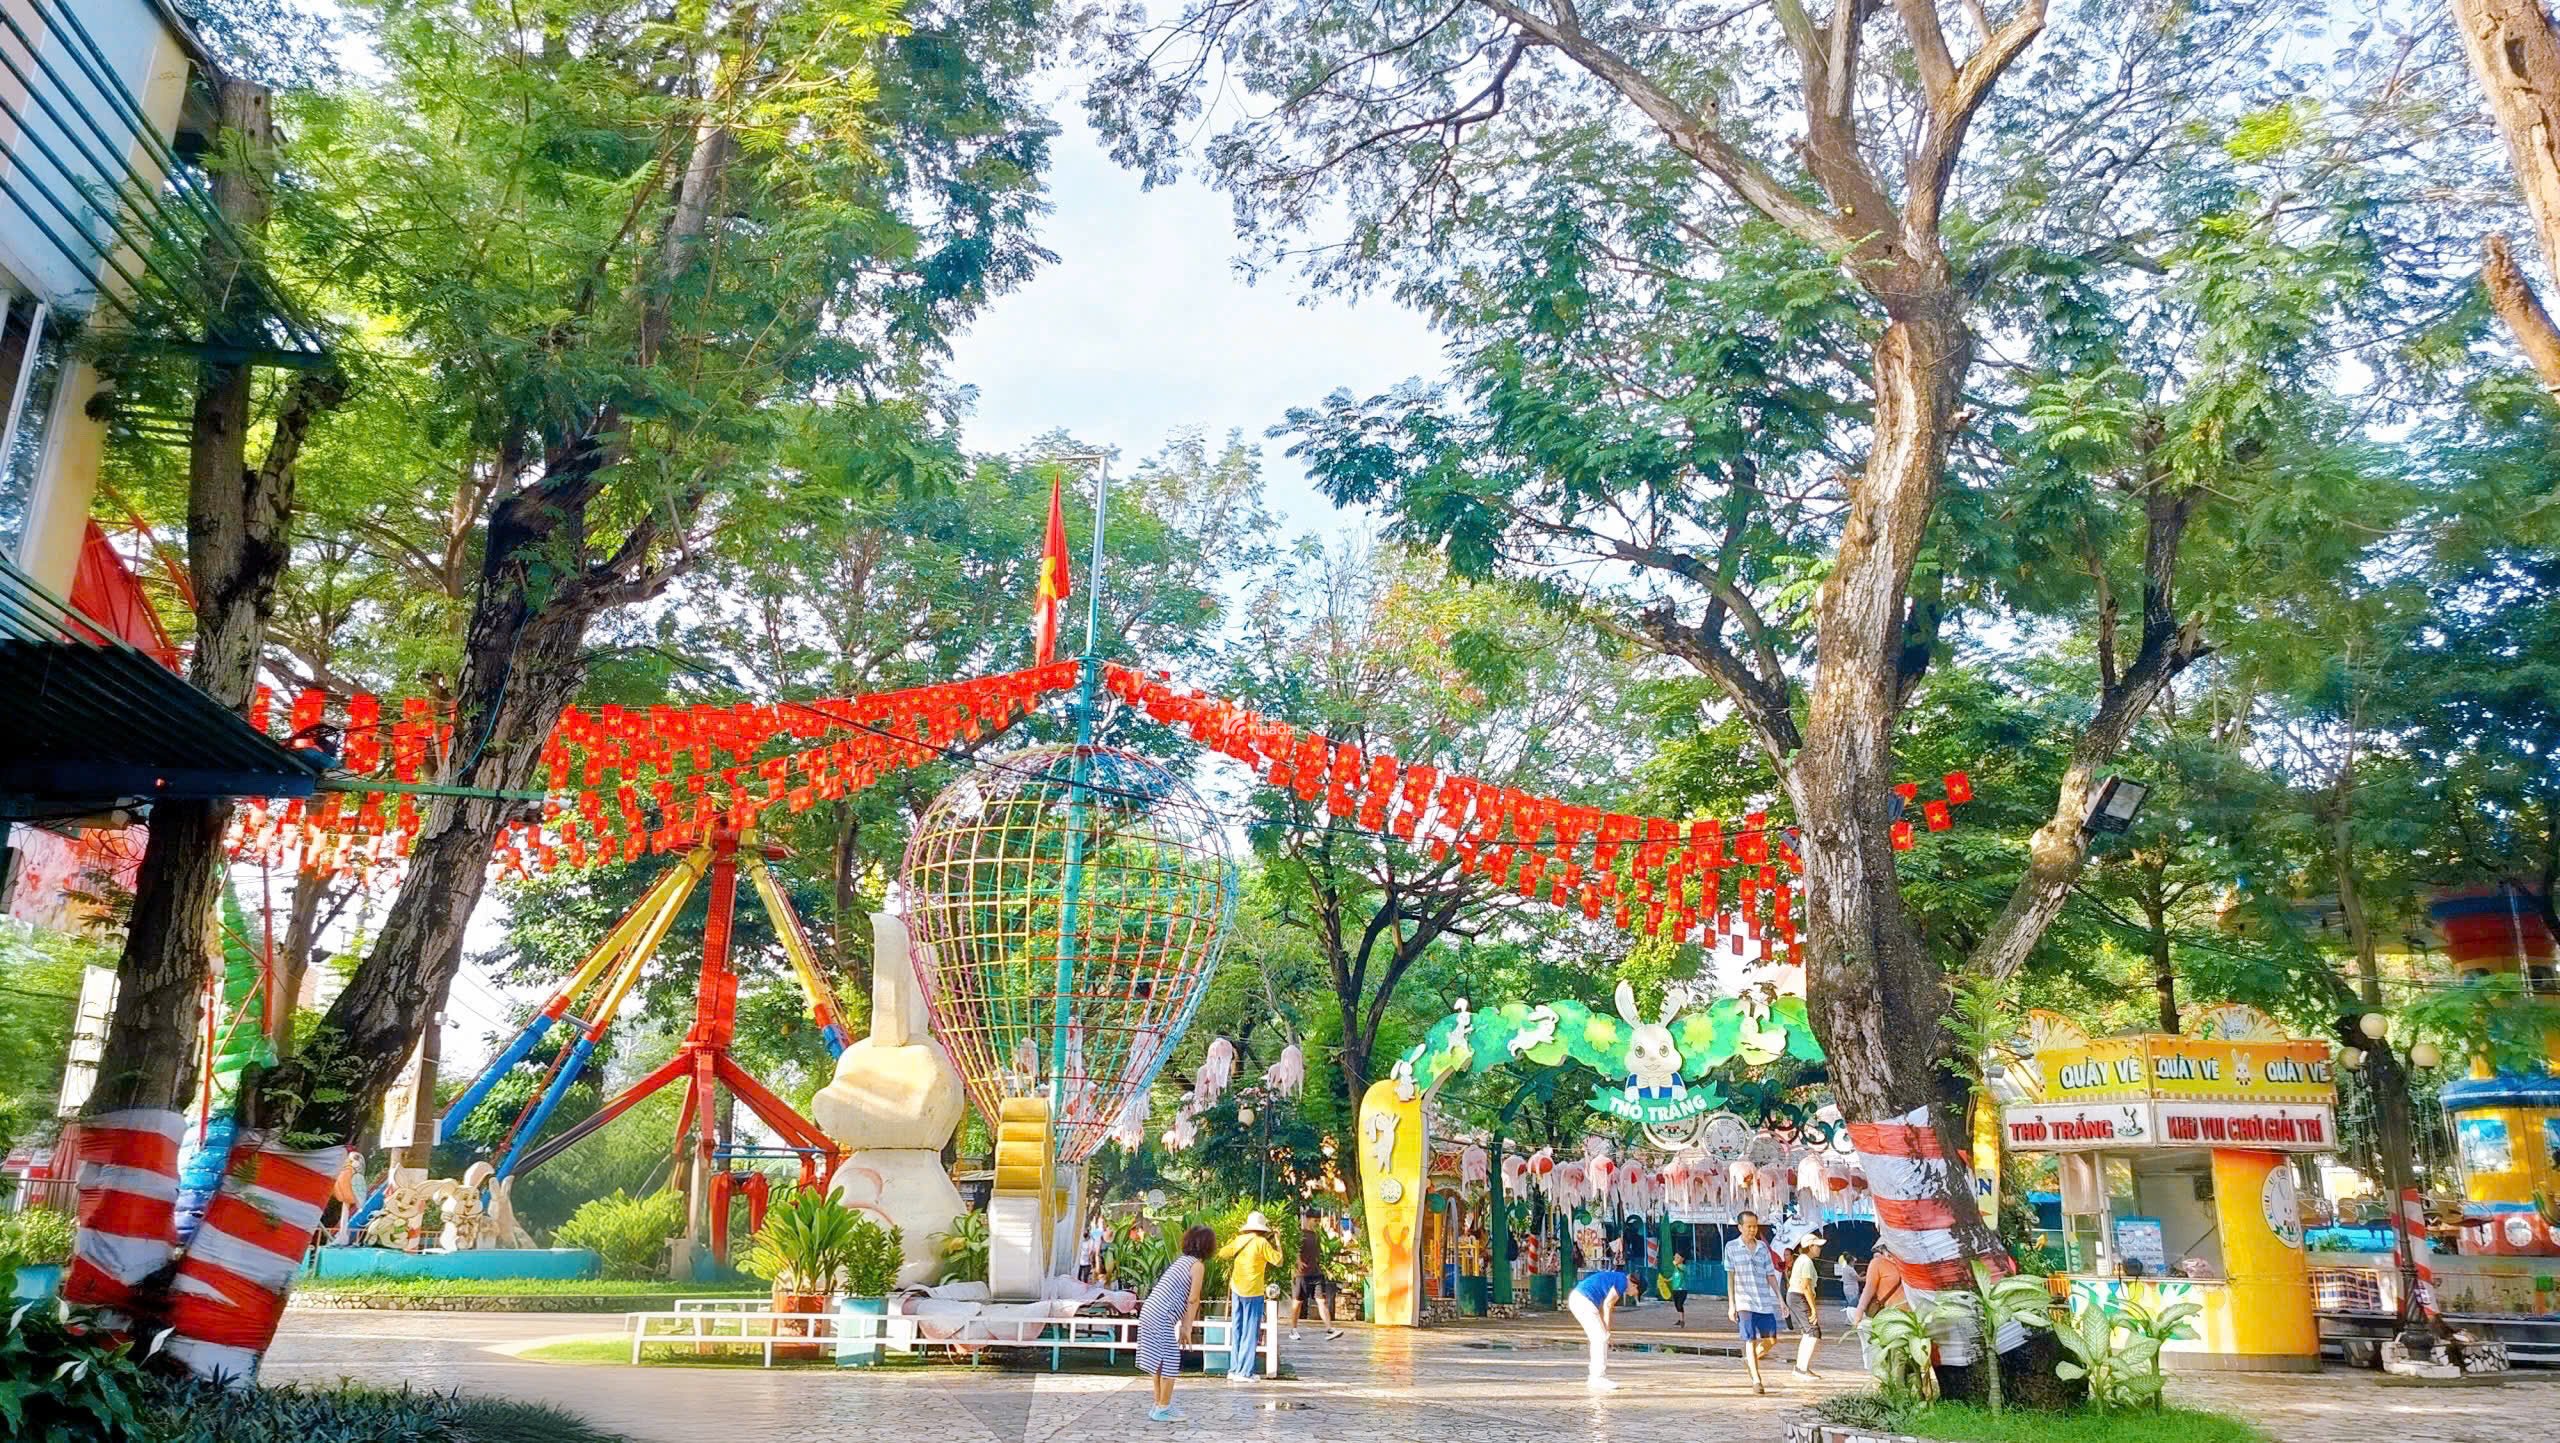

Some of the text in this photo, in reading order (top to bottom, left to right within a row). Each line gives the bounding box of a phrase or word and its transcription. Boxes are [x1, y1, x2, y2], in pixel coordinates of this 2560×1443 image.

[2009, 1113, 2114, 1140] THỎ TRẮNG
[2166, 1110, 2324, 1142] KHU VUI CHƠI GIẢI TRÍ
